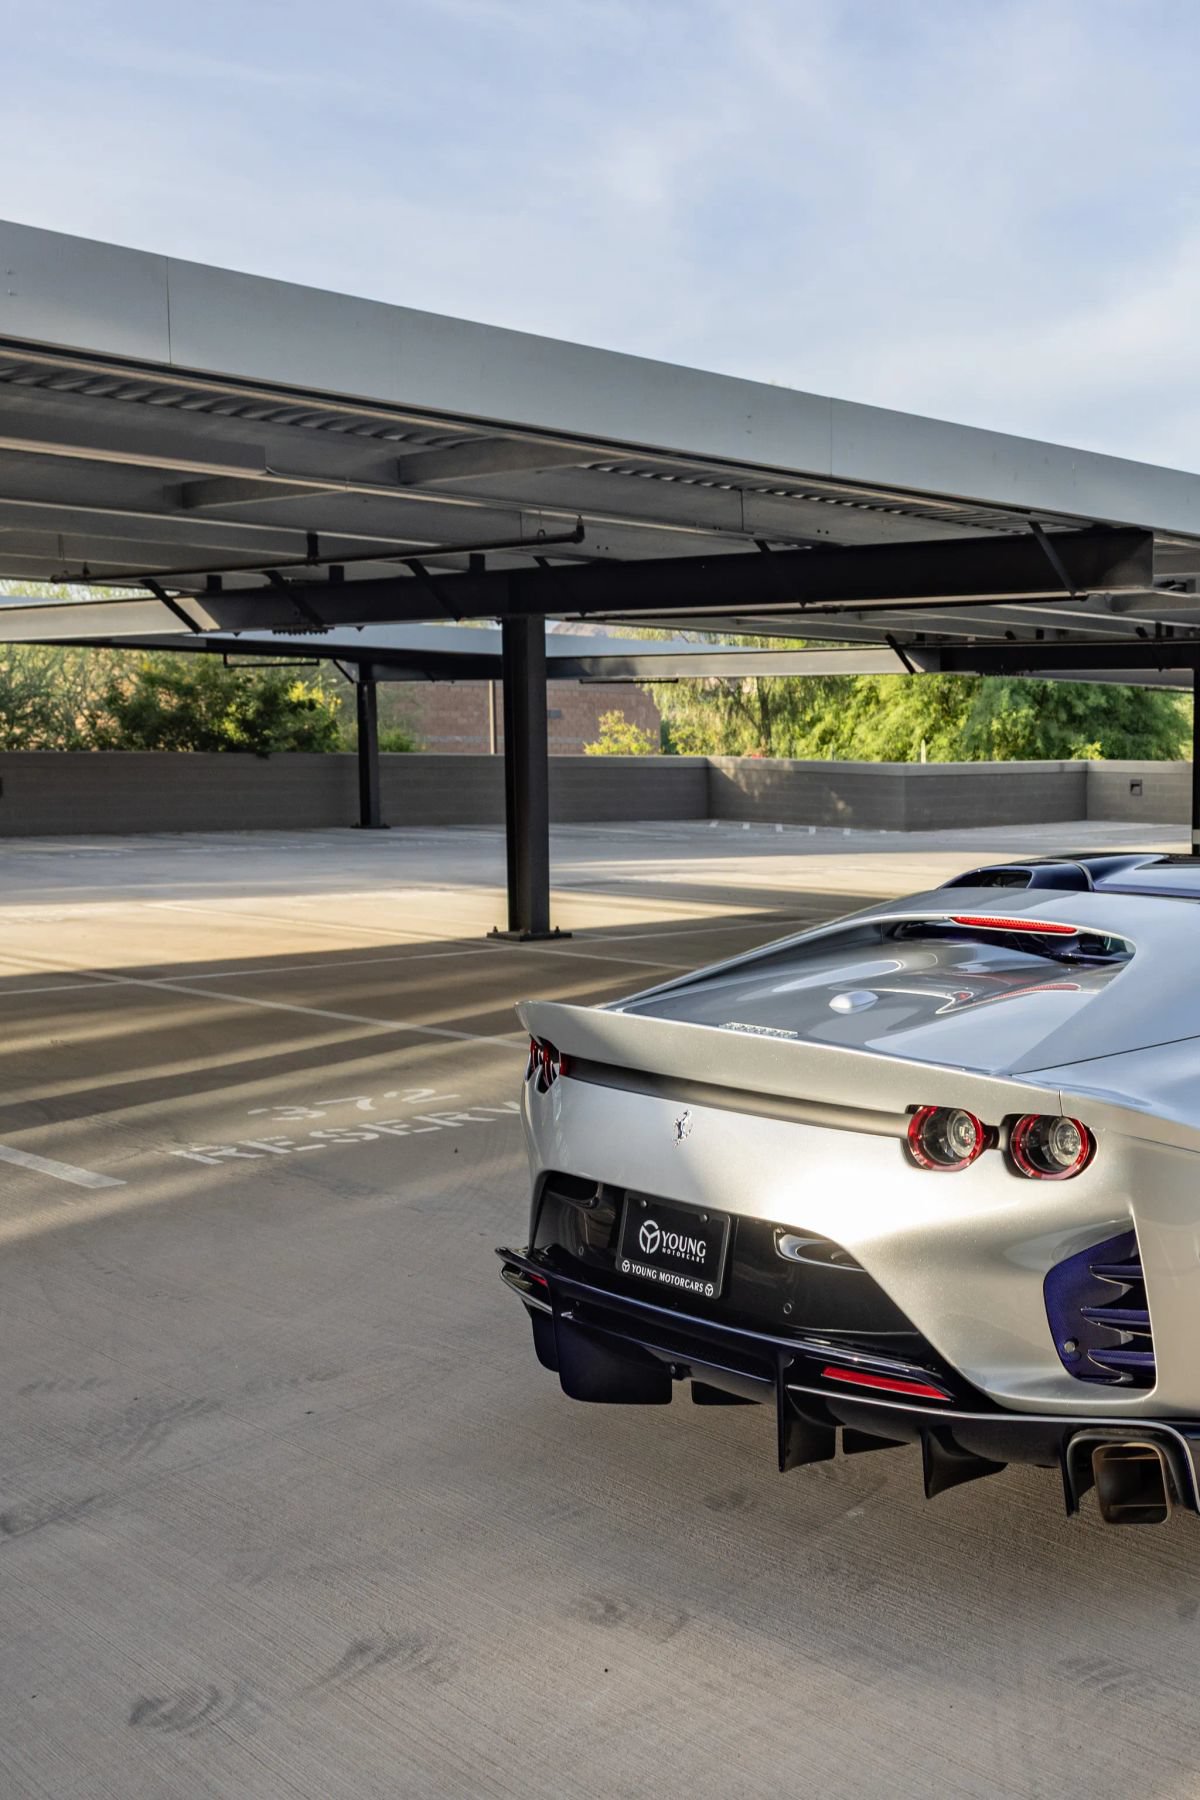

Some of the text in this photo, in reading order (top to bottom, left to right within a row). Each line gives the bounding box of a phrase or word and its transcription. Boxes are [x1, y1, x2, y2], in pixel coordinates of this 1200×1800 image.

[247, 1088, 460, 1121] 372
[661, 1230, 706, 1257] YOUNG
[662, 1247, 704, 1264] MOTORCARS
[631, 1263, 703, 1293] YOUNG MOTORCARS
